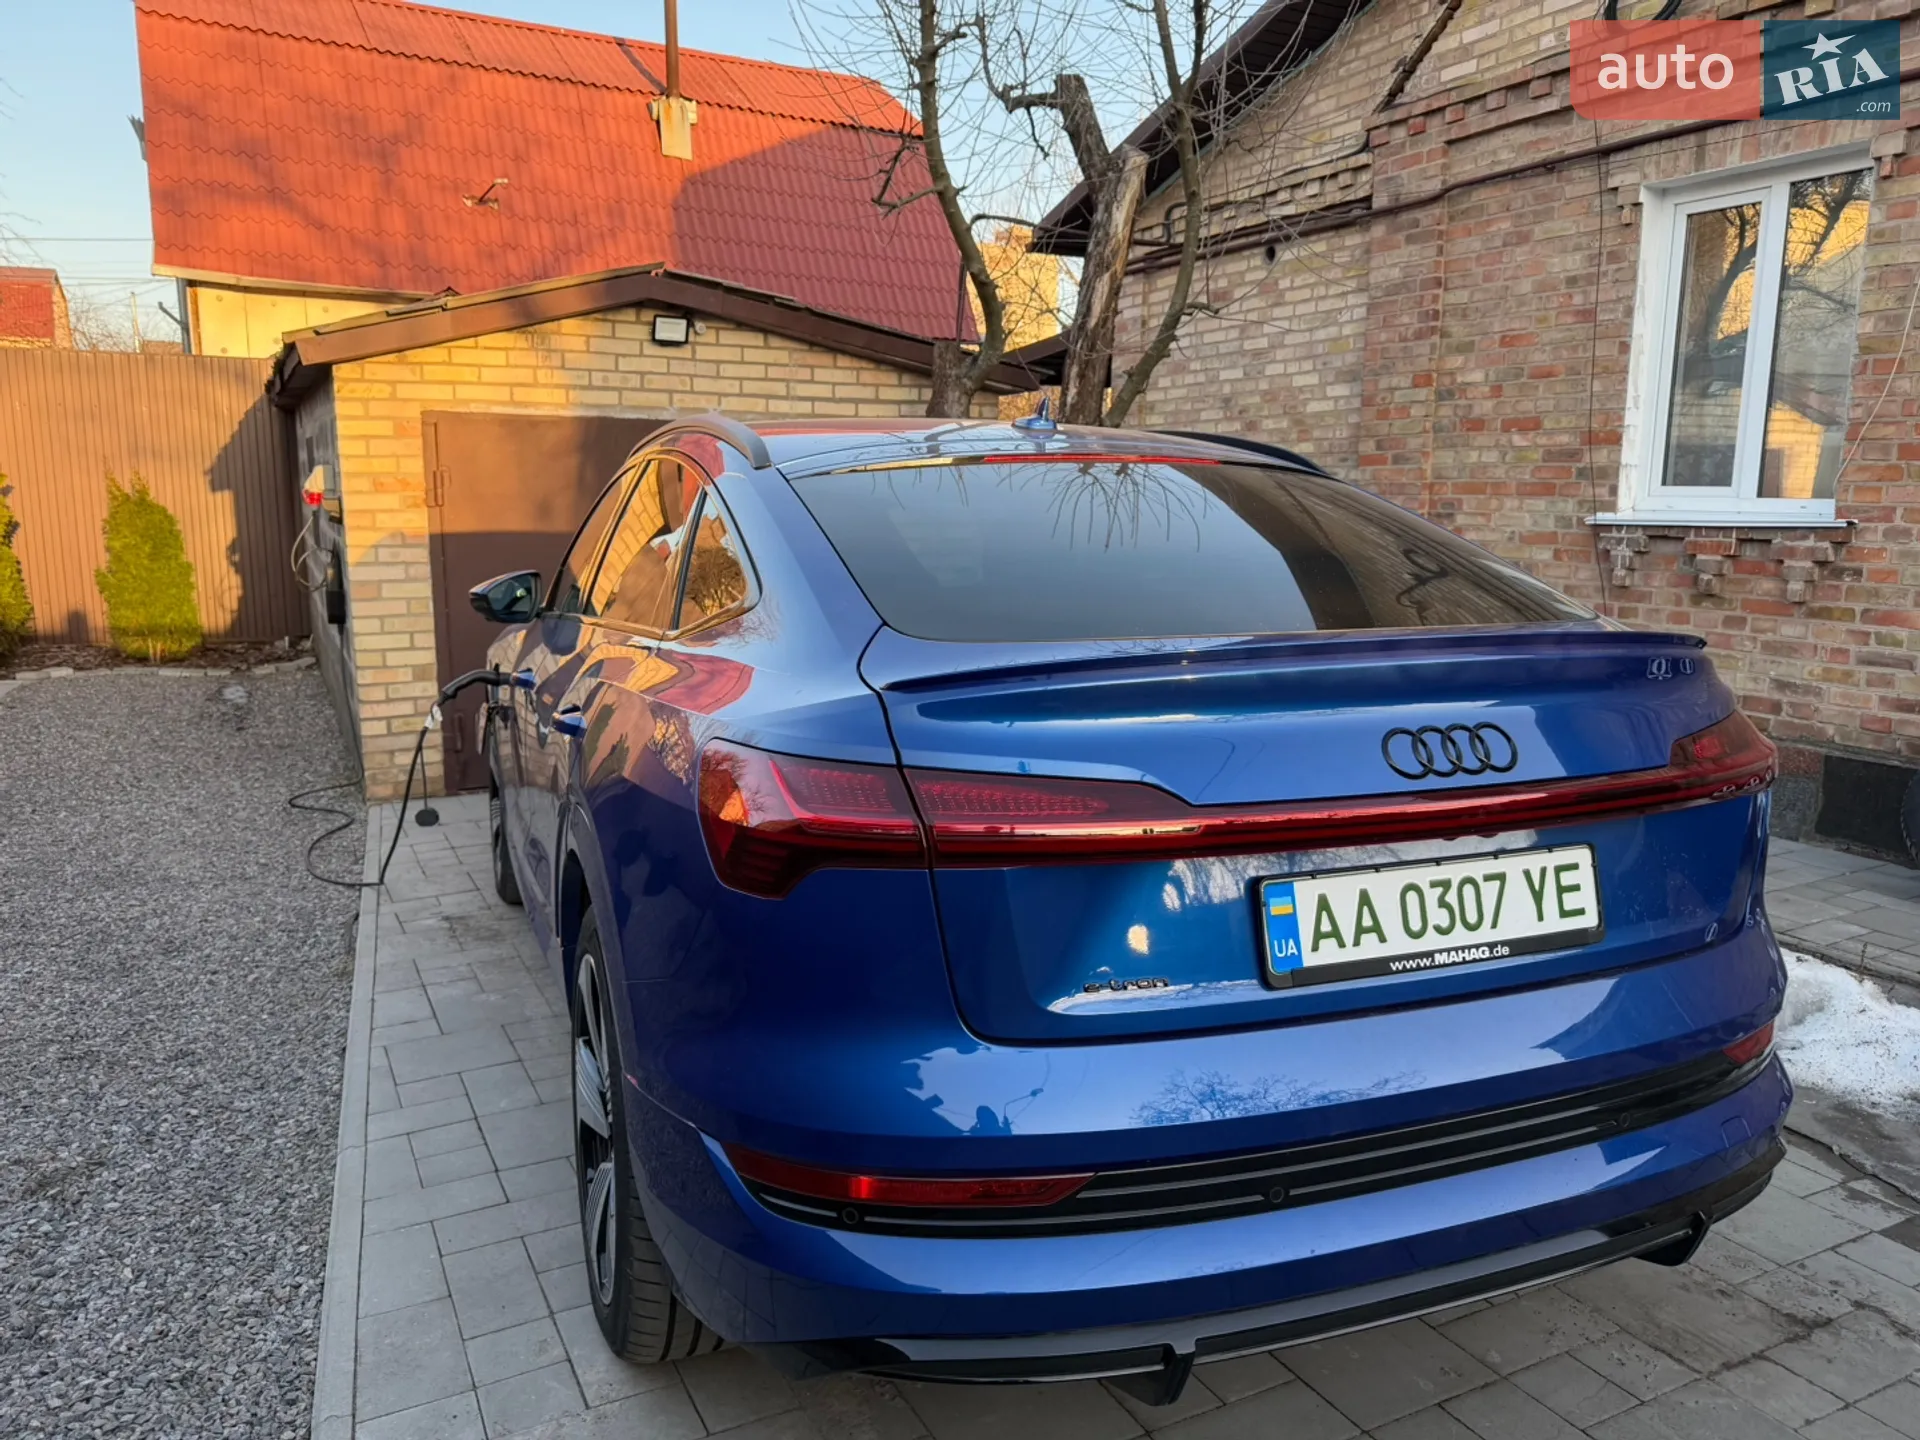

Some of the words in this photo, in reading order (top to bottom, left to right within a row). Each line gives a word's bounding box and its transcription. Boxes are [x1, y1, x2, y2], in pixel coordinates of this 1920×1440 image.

[1311, 888, 1388, 953] AA
[1399, 871, 1507, 940] 0307
[1522, 862, 1587, 922] YE
[1274, 938, 1299, 958] UA
[1389, 945, 1511, 972] www.MAHAG.de
[1083, 978, 1169, 993] e-tron
